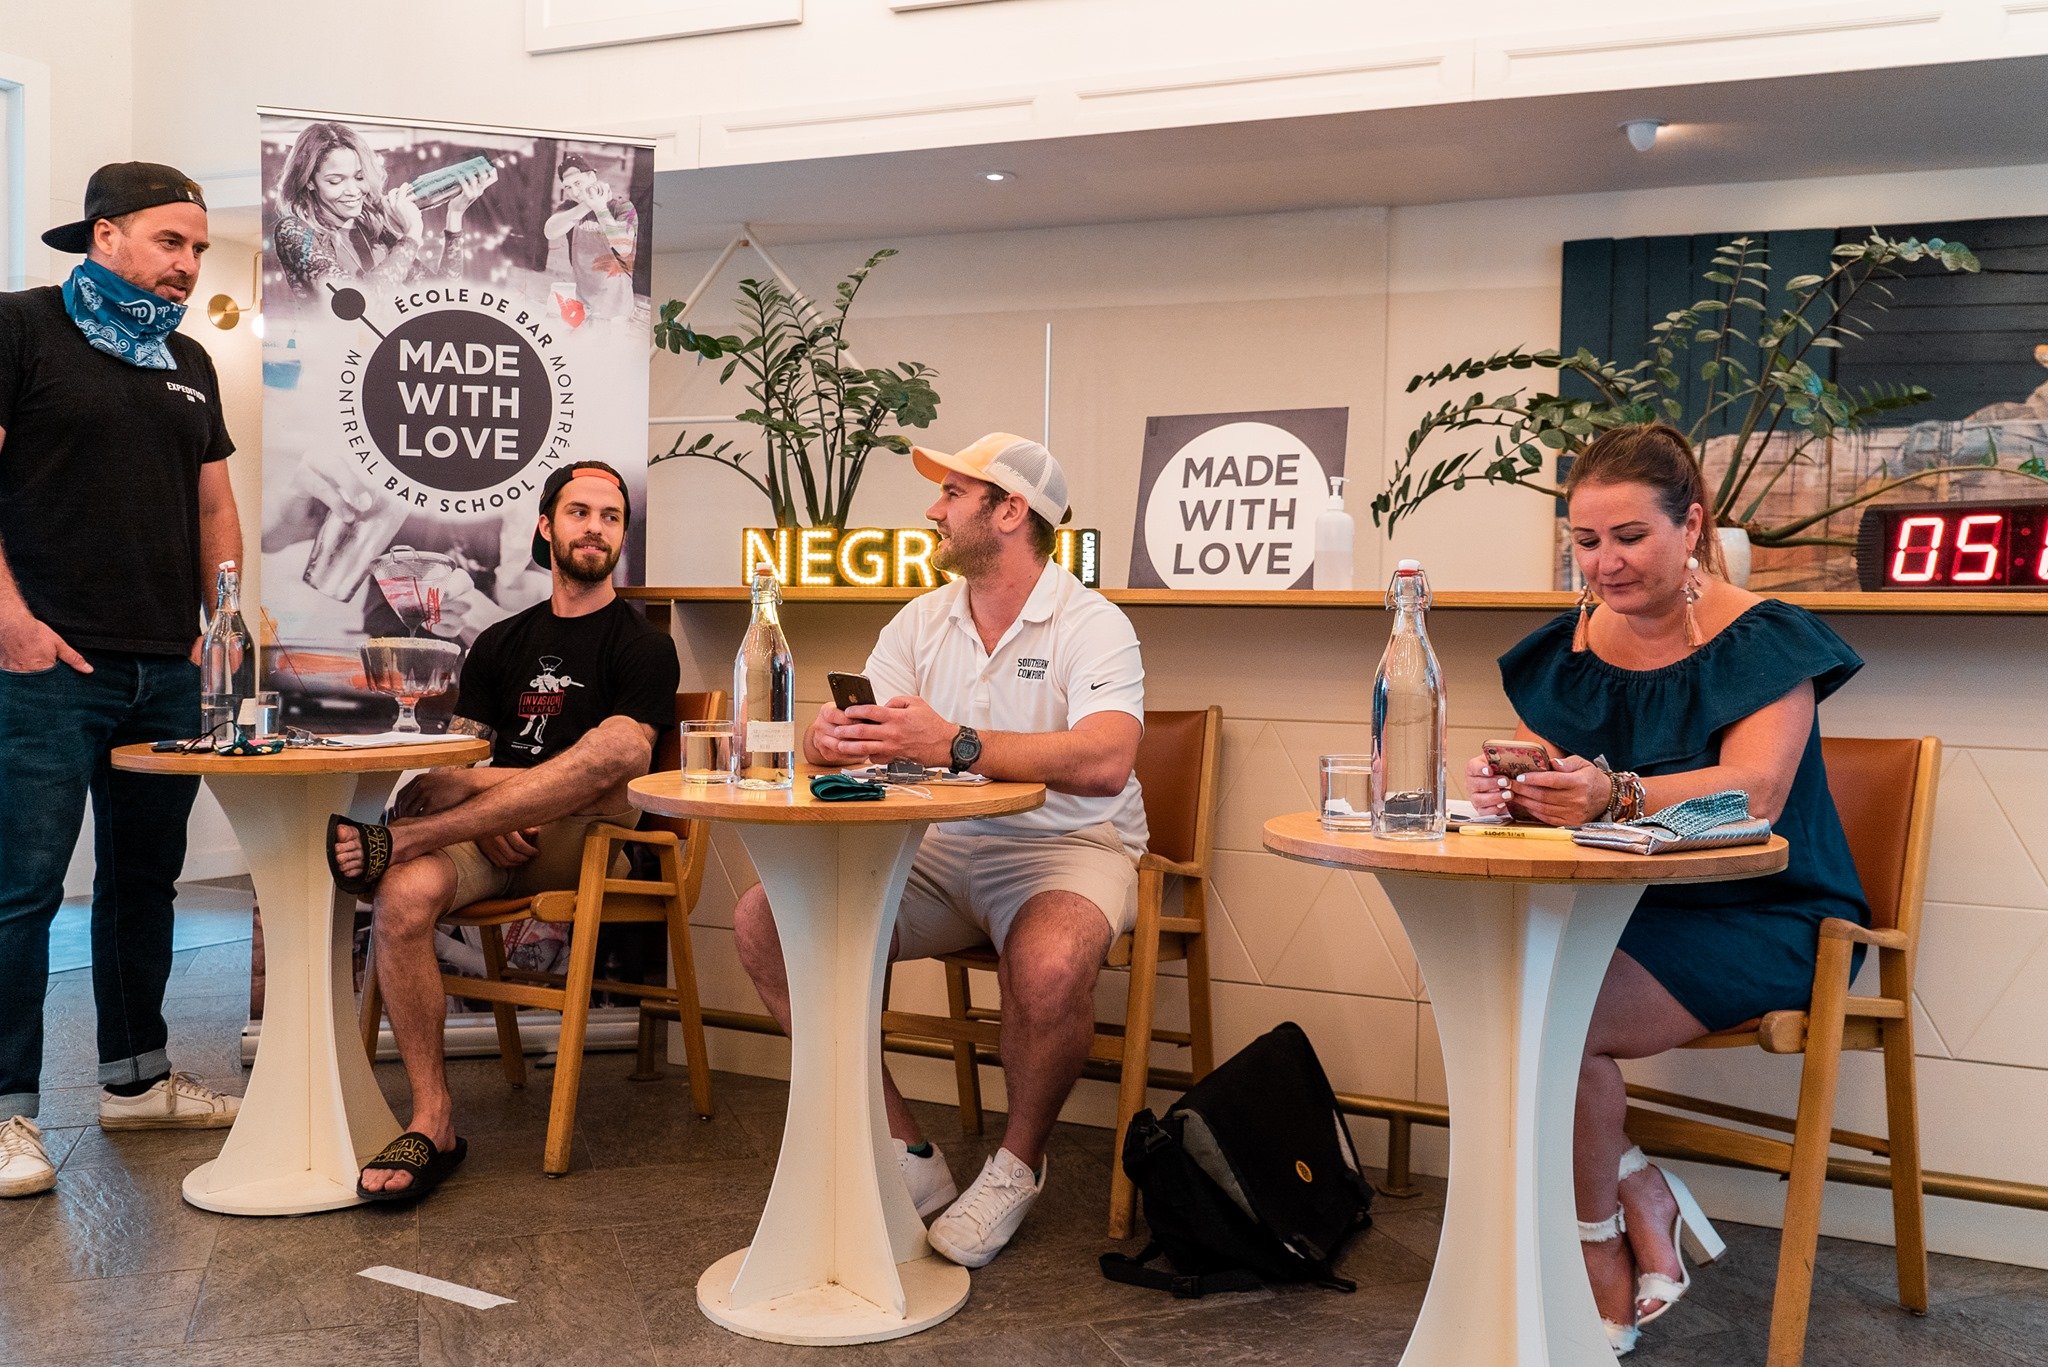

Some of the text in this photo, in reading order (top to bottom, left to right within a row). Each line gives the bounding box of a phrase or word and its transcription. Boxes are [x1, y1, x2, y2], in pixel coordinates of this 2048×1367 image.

[399, 338, 520, 377] MADE
[394, 288, 574, 470] ÉCOLE DE BAR MONTRÉAL
[397, 381, 520, 419] WITH
[338, 349, 535, 514] MONTREAL BAR SCHOOL
[398, 424, 519, 461] LOVE
[1182, 453, 1300, 488] MADE
[1178, 497, 1297, 531] WITH
[743, 528, 1075, 587] NEGRI
[1082, 532, 1096, 584] CAMPARI
[1173, 542, 1293, 575] LOVE
[1017, 658, 1050, 669] SOUTHERN
[1017, 668, 1046, 680] COMFORT
[522, 695, 561, 706] INVASION
